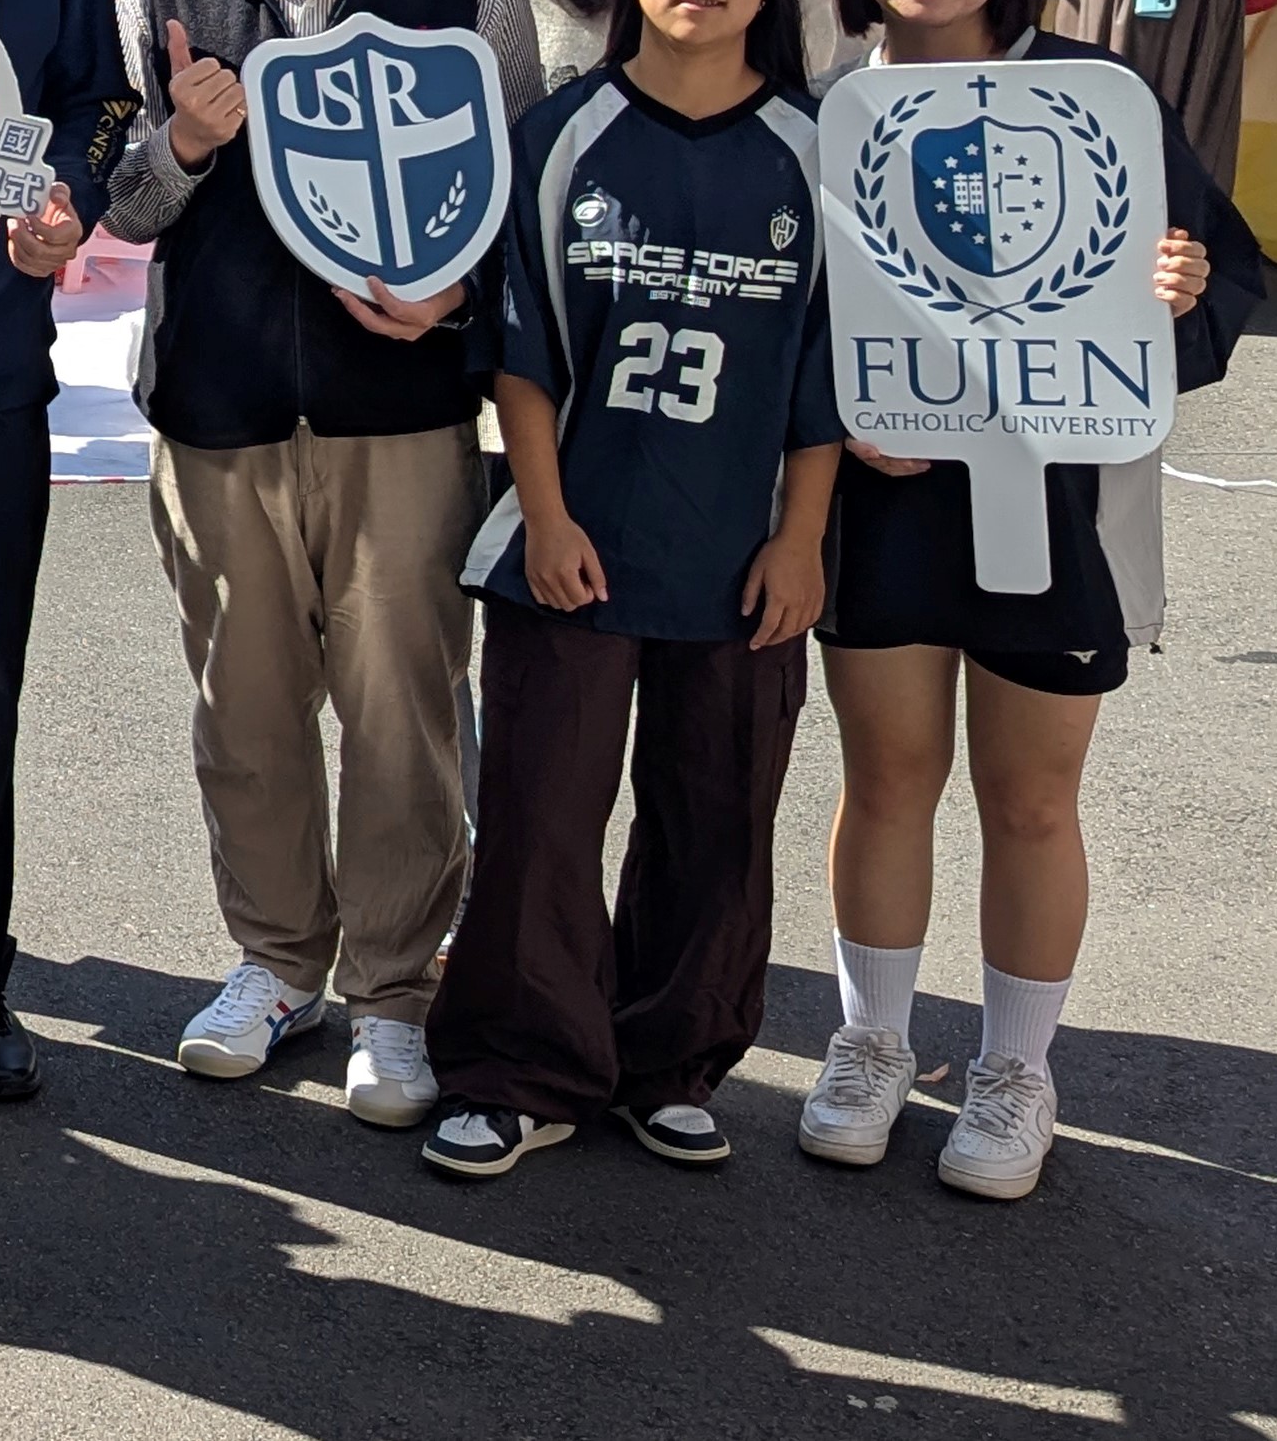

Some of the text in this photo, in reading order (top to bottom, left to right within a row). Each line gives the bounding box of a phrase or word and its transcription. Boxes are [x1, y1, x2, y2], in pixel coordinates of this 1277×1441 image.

[277, 49, 437, 130] USR
[952, 172, 1026, 215] 輔仁
[567, 241, 799, 284] SPACE FORCE
[628, 269, 738, 296] ACADEMY
[649, 290, 679, 301] EST
[606, 322, 725, 424] 23
[850, 337, 1153, 423] FUJEN
[855, 412, 1157, 436] CATHOLIC UNIVERSITY
